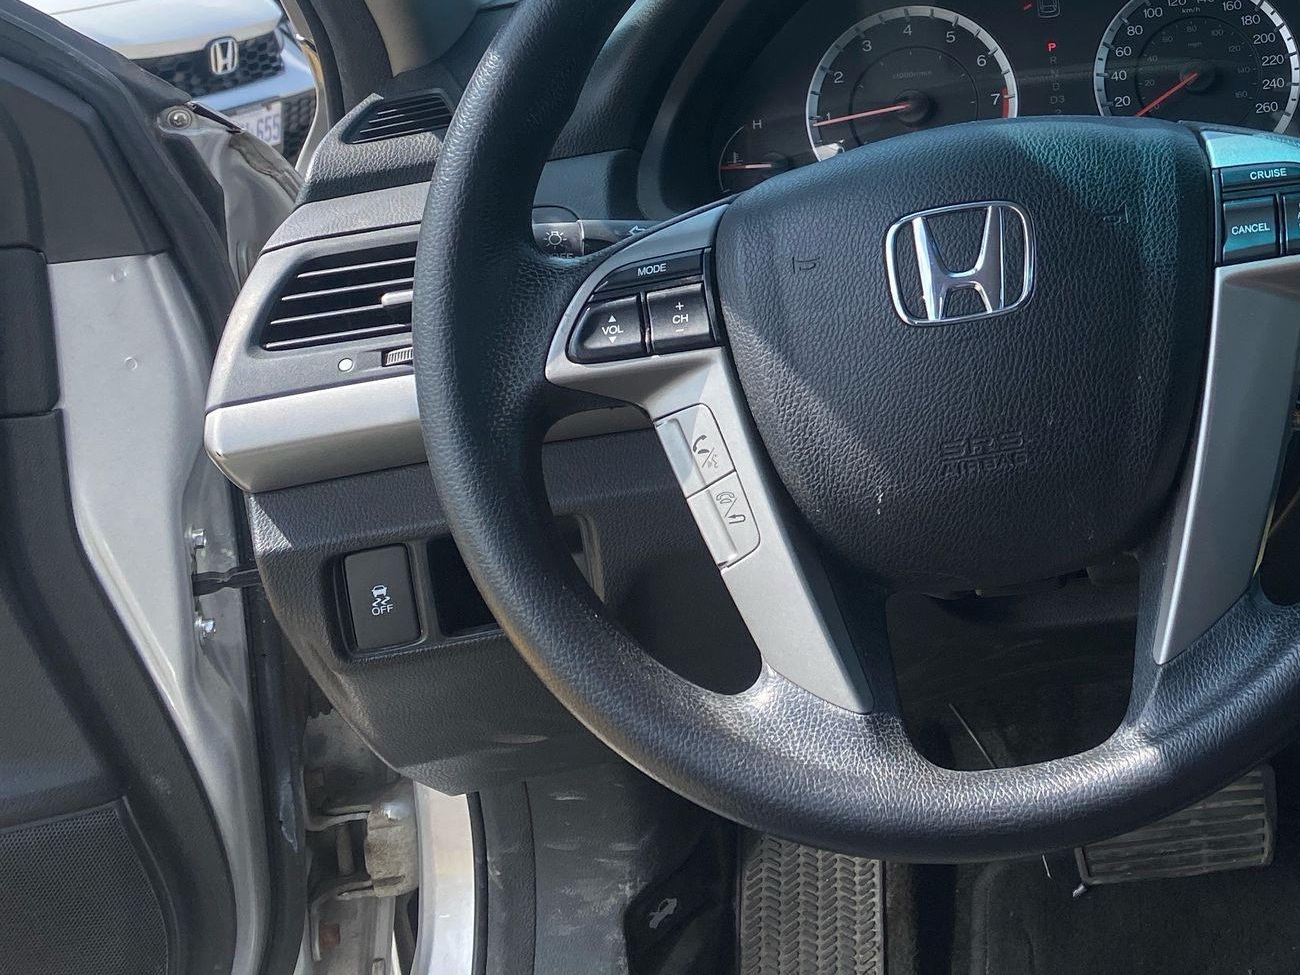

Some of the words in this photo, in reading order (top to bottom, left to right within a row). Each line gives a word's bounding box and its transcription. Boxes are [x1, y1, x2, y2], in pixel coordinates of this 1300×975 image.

[1181, 6, 1201, 14] km/h
[1222, 0, 1242, 11] 160
[1143, 6, 1163, 19] 100
[1240, 14, 1261, 26] 180
[902, 24, 913, 36] 4
[1126, 24, 1143, 36] 80
[944, 31, 956, 43] 5
[1252, 32, 1276, 45] 200
[861, 40, 874, 52] 3
[1048, 42, 1057, 51] P
[1115, 46, 1132, 57] 60
[976, 54, 987, 67] 6
[1261, 54, 1284, 67] 220
[833, 71, 844, 84] 2
[1110, 71, 1127, 81] 40
[1262, 78, 1285, 90] 240
[990, 93, 1000, 106] 7
[1114, 96, 1131, 108] 20
[1255, 102, 1279, 114] 260
[752, 119, 763, 130] H
[1249, 168, 1287, 180] CRUISE
[1231, 222, 1270, 235] CANCEL
[637, 263, 667, 276] MODE
[672, 314, 689, 324] CH
[602, 325, 624, 336] VOL
[371, 604, 394, 616] OFF
